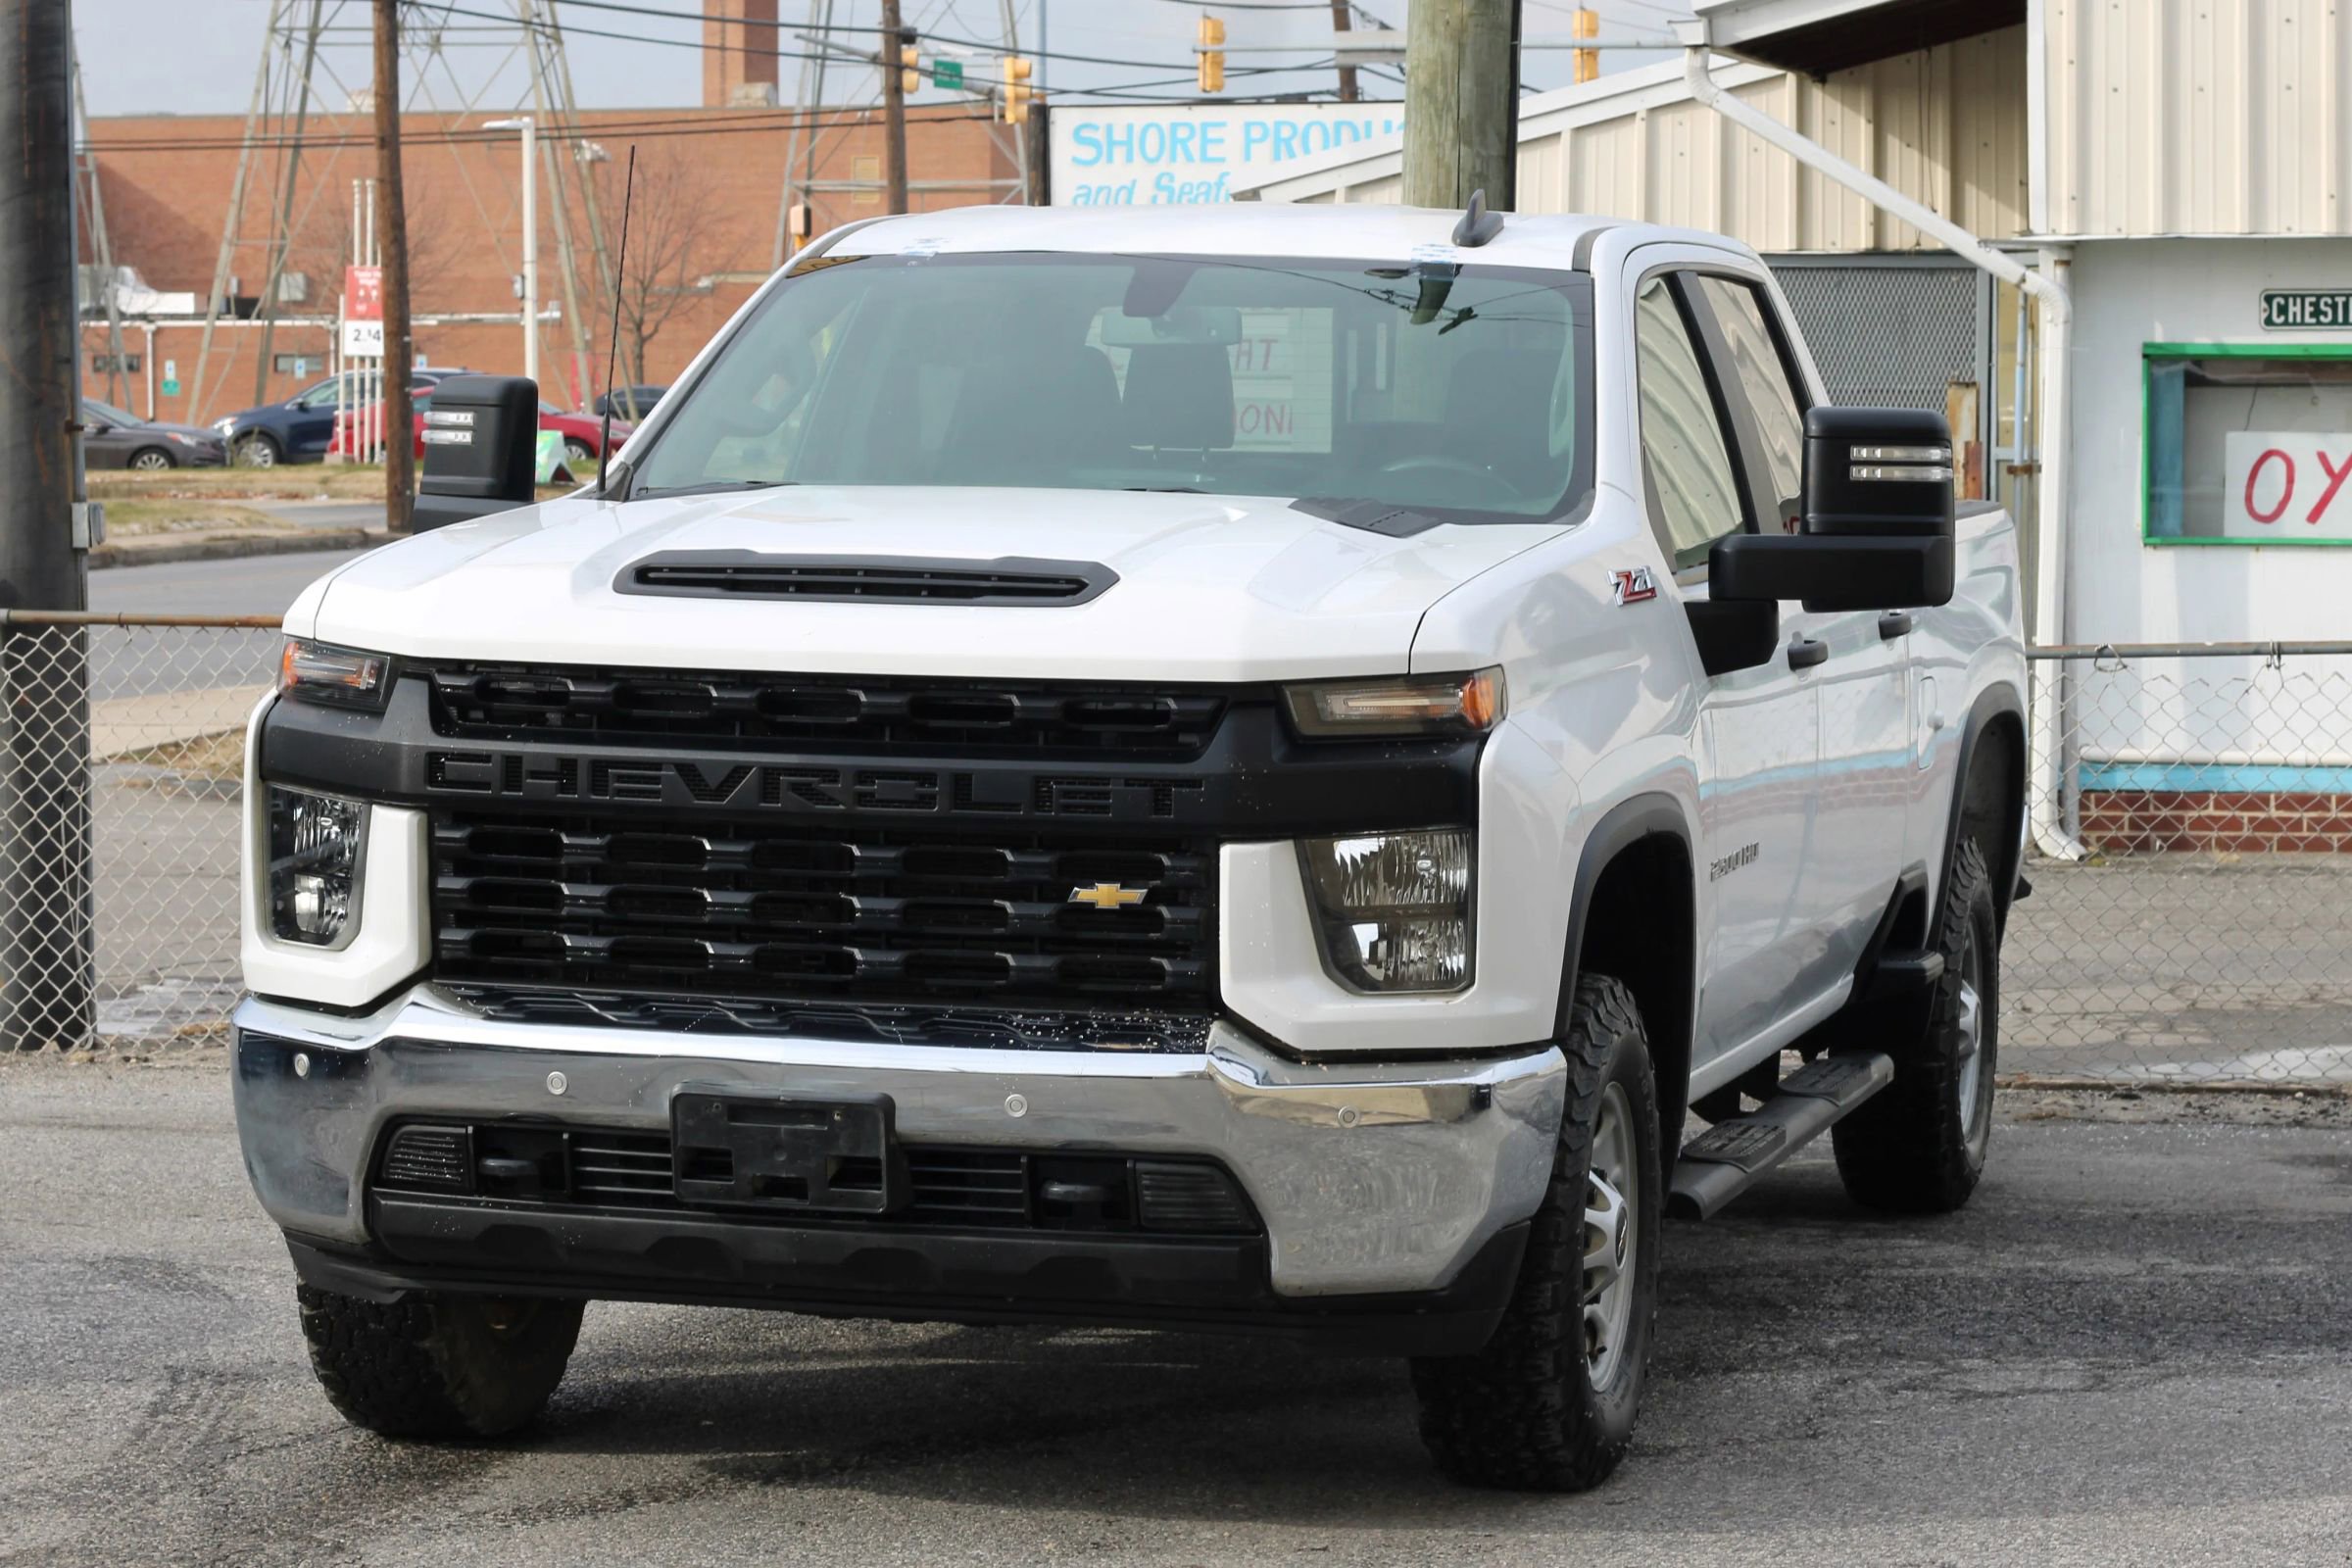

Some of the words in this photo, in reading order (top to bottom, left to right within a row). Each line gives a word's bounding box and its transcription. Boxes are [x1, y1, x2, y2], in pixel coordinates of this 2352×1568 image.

[1071, 121, 1229, 167] SHORE
[1244, 120, 1406, 162] PROD
[1151, 171, 1232, 205] Seaf
[2272, 296, 2352, 324] CHEST
[424, 750, 1205, 818] CHEVROLET
